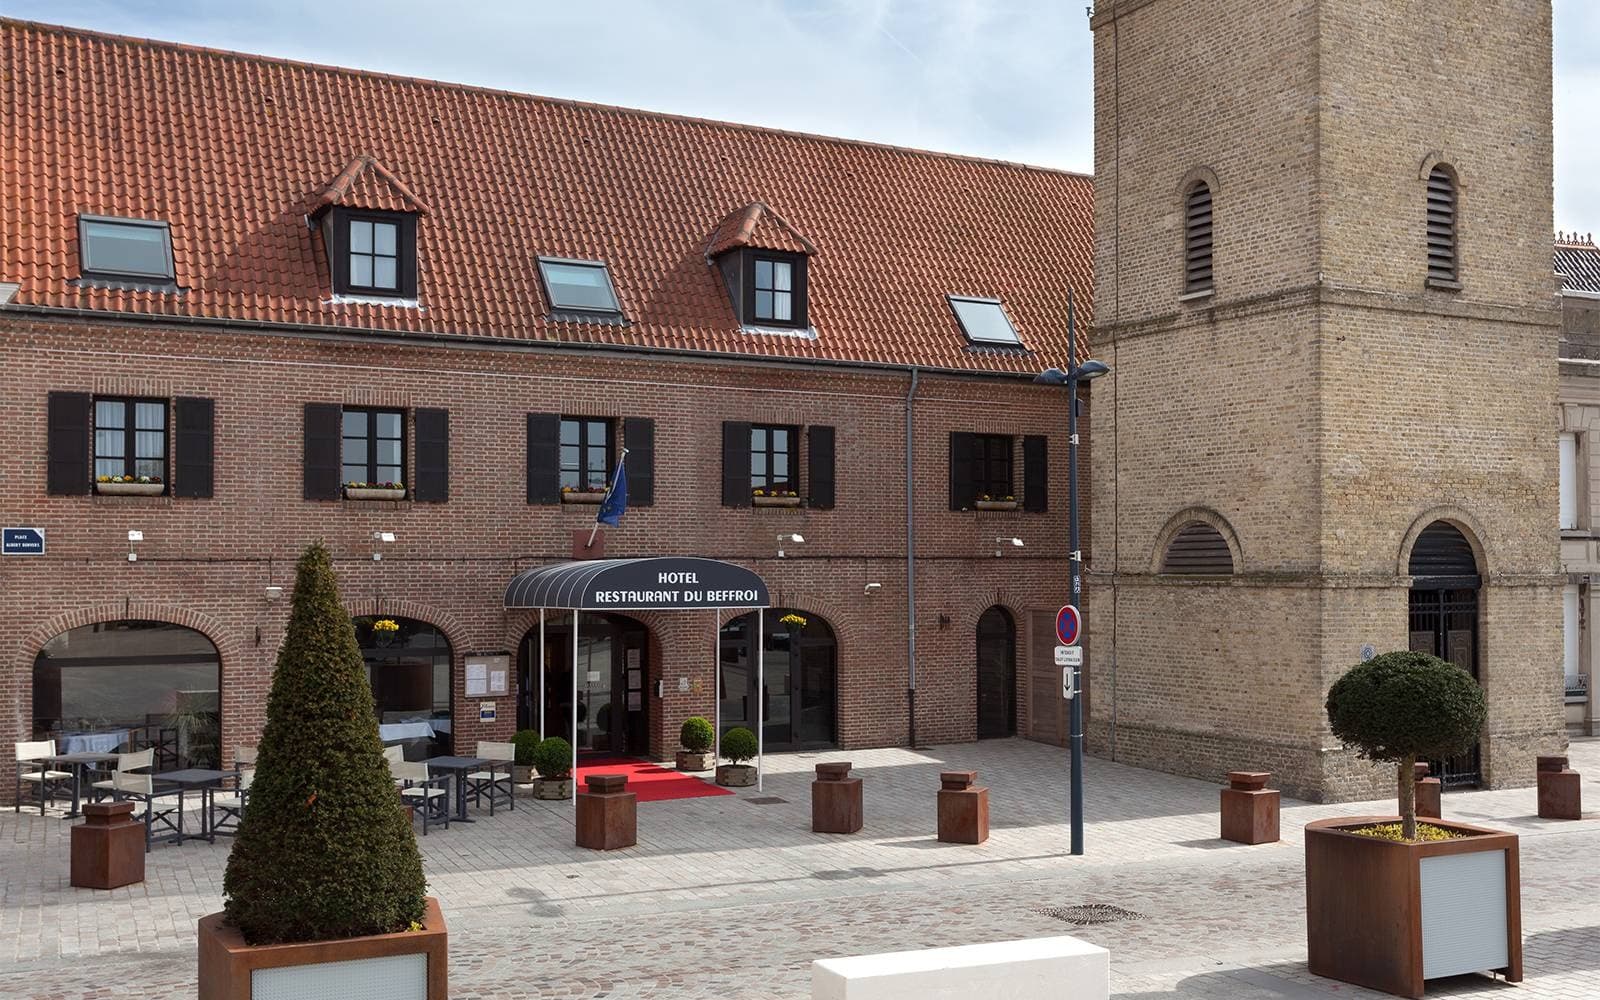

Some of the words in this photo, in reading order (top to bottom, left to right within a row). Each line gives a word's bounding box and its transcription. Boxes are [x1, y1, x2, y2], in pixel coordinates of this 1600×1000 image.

[658, 572, 699, 584] HOTEL
[595, 590, 680, 603] RESTAURANT
[684, 590, 703, 602] DU
[706, 590, 758, 602] BEFFROI
